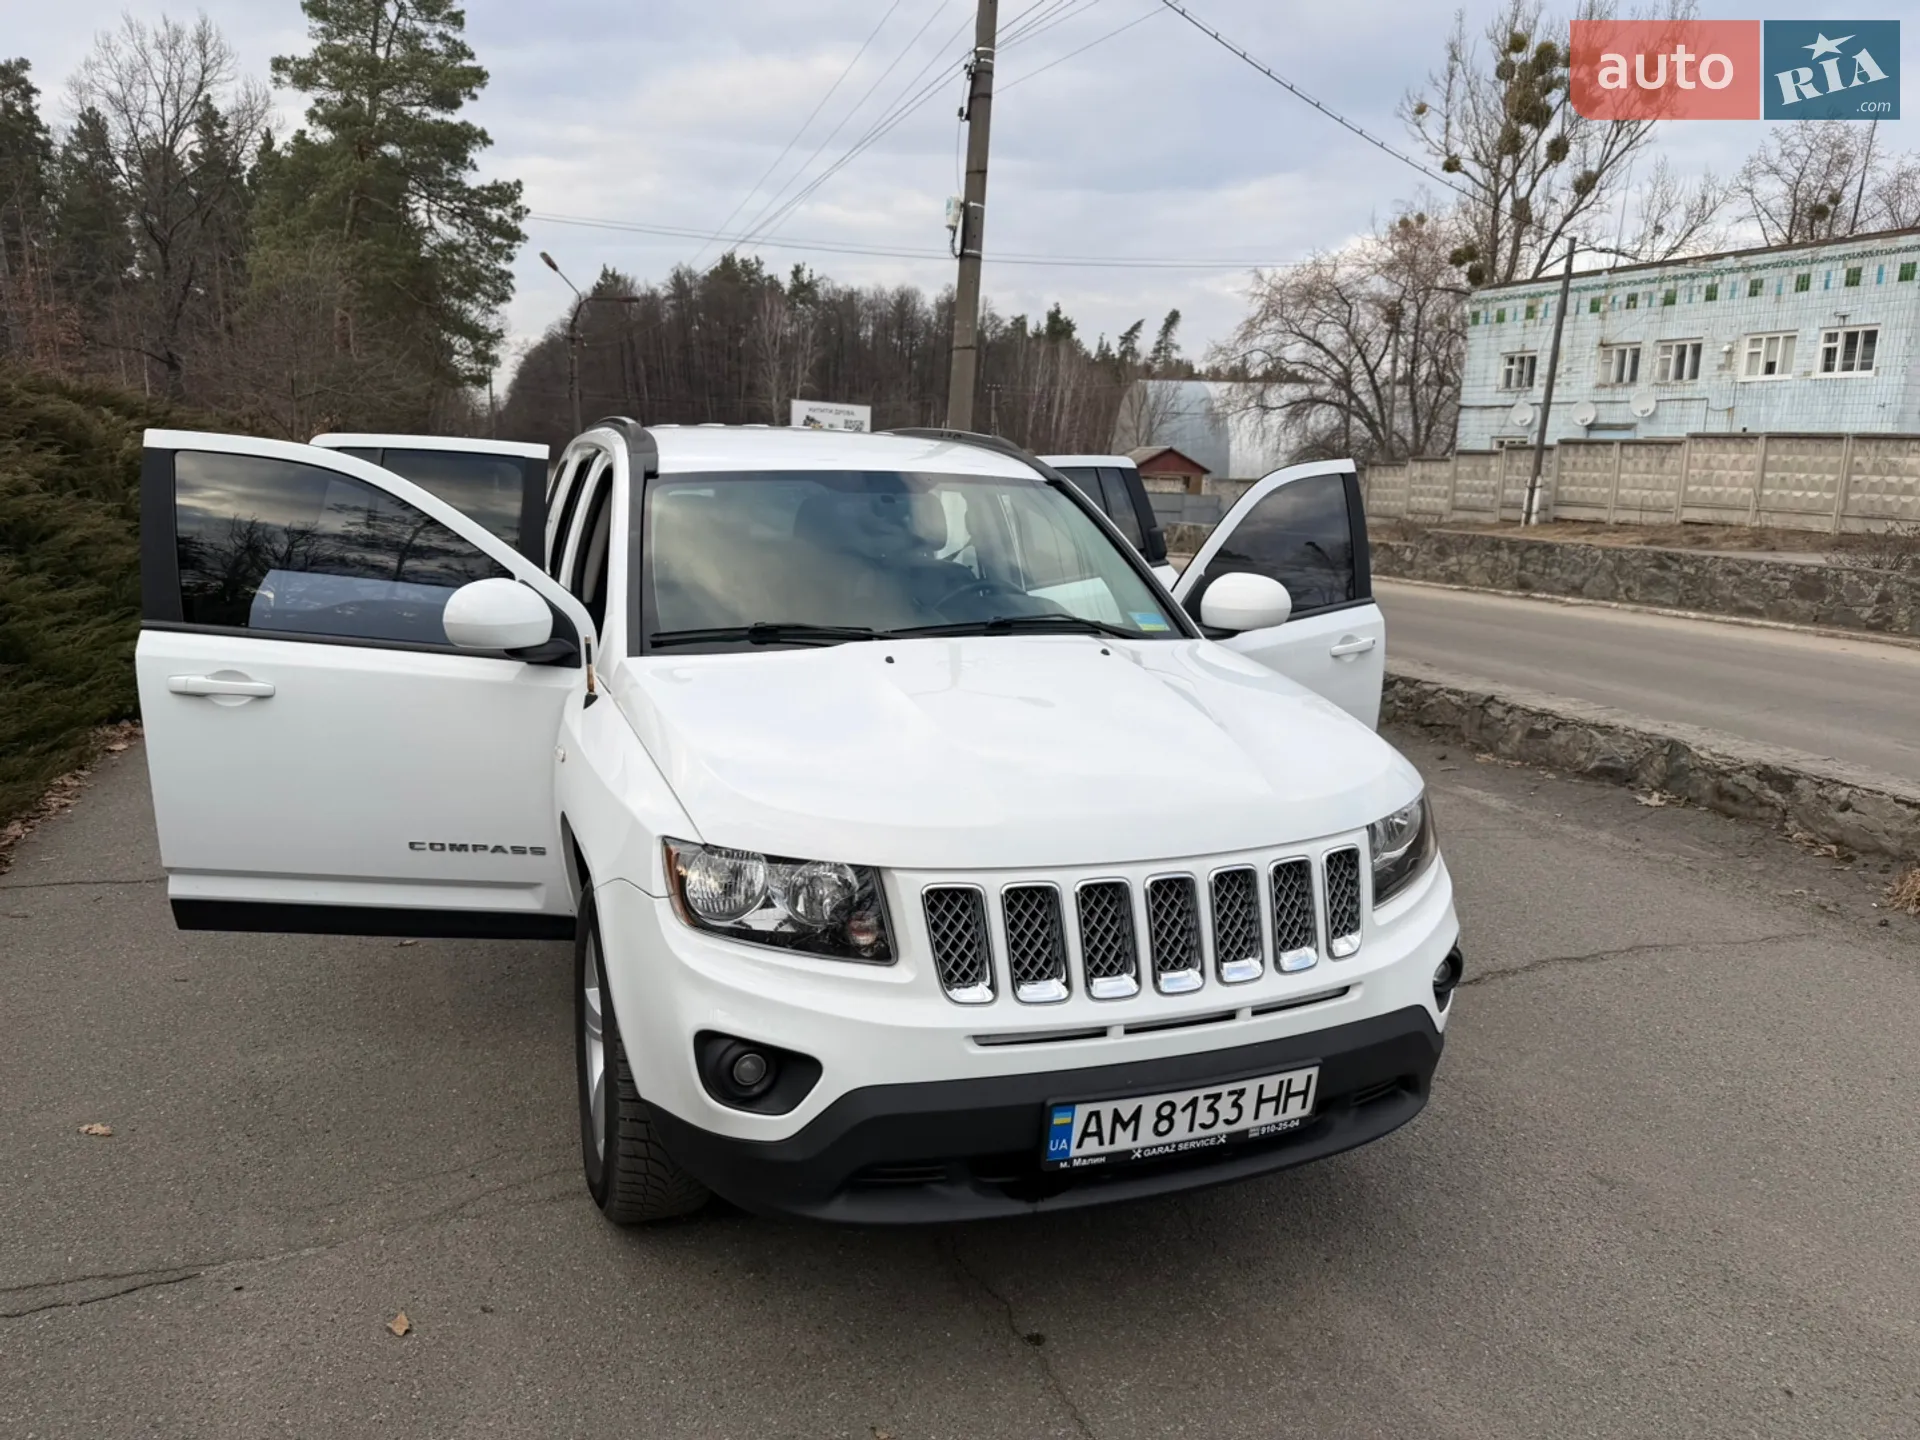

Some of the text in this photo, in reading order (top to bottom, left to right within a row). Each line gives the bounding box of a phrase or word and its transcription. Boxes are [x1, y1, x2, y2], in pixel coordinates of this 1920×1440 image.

[408, 841, 547, 856] COMPASS
[1076, 1074, 1313, 1148] AM 8133 HH
[1050, 1139, 1068, 1151] UA
[1177, 1137, 1217, 1152] SERVICE
